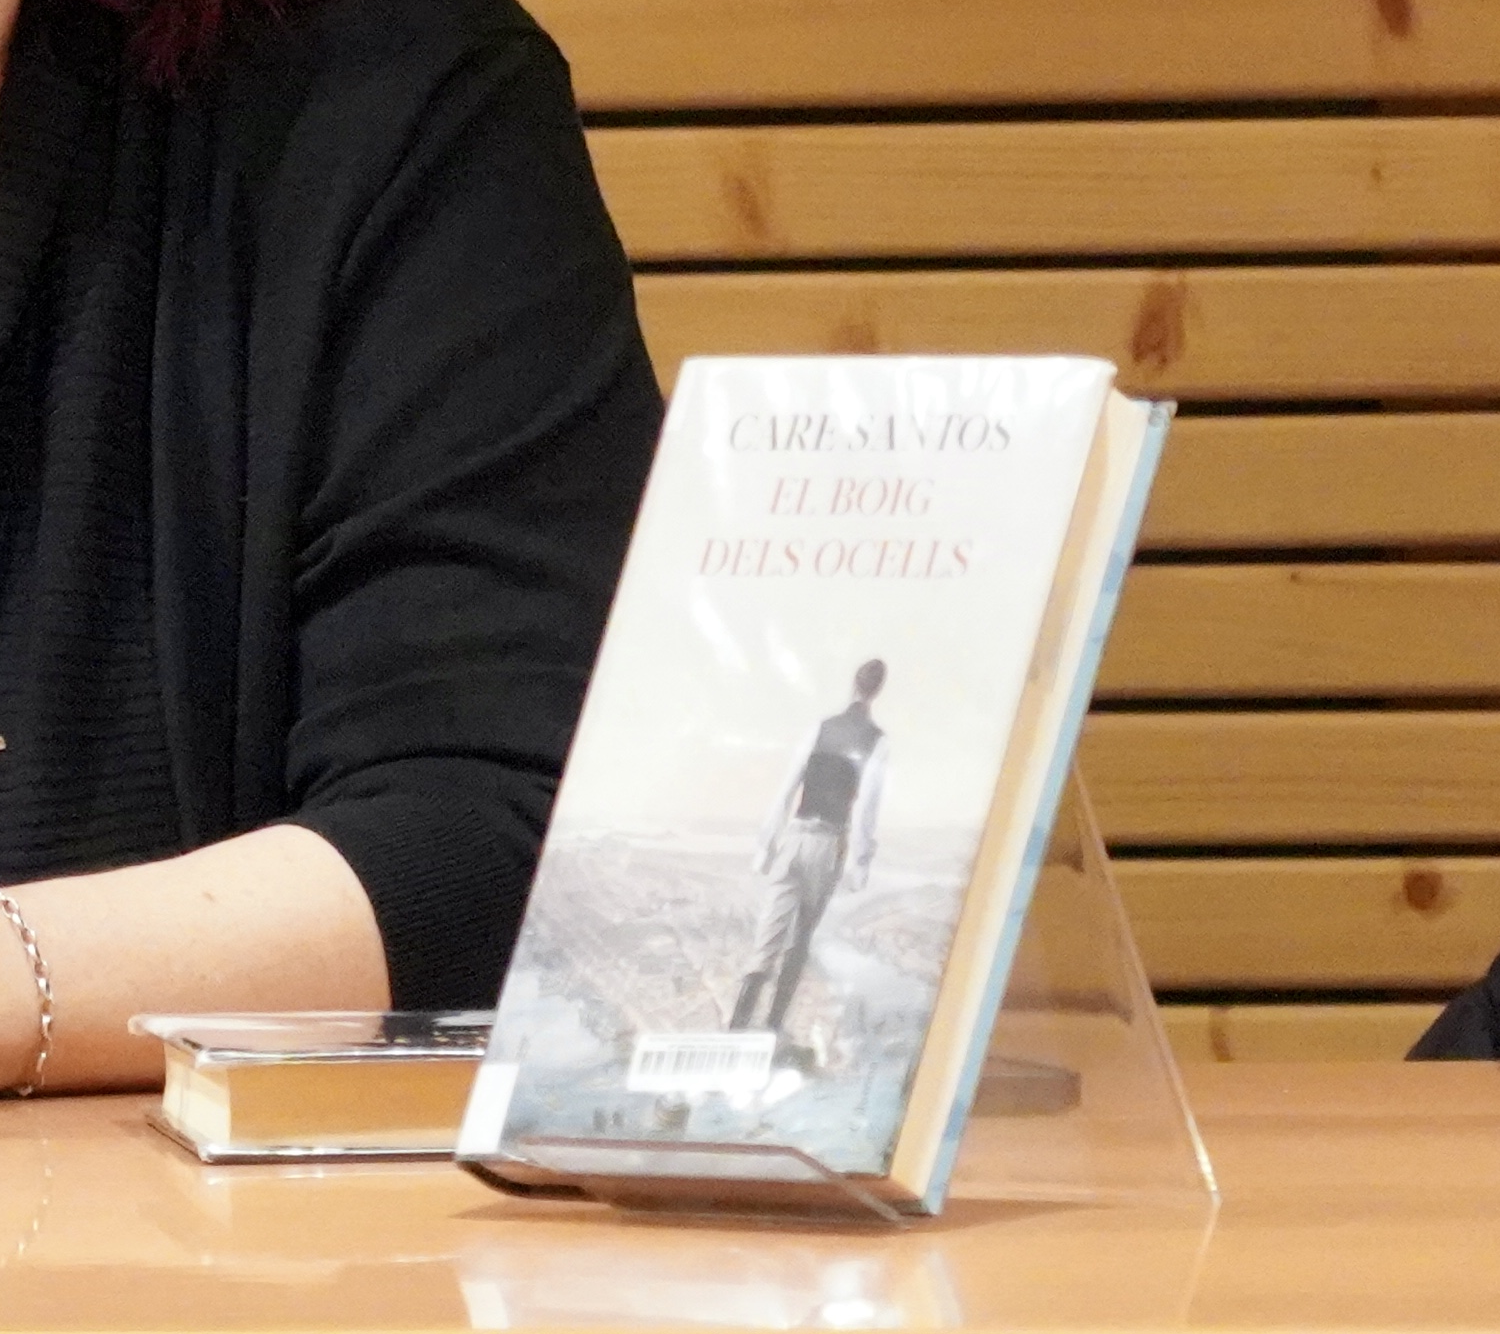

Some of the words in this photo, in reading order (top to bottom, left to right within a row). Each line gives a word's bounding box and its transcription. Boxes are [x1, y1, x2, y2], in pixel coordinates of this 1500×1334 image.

[729, 413, 836, 452] CARE
[848, 413, 1012, 452] SANTOS
[769, 476, 818, 516] EL
[830, 476, 936, 516] BOIG
[698, 538, 805, 578] DELS
[813, 538, 976, 579] OCELLS
